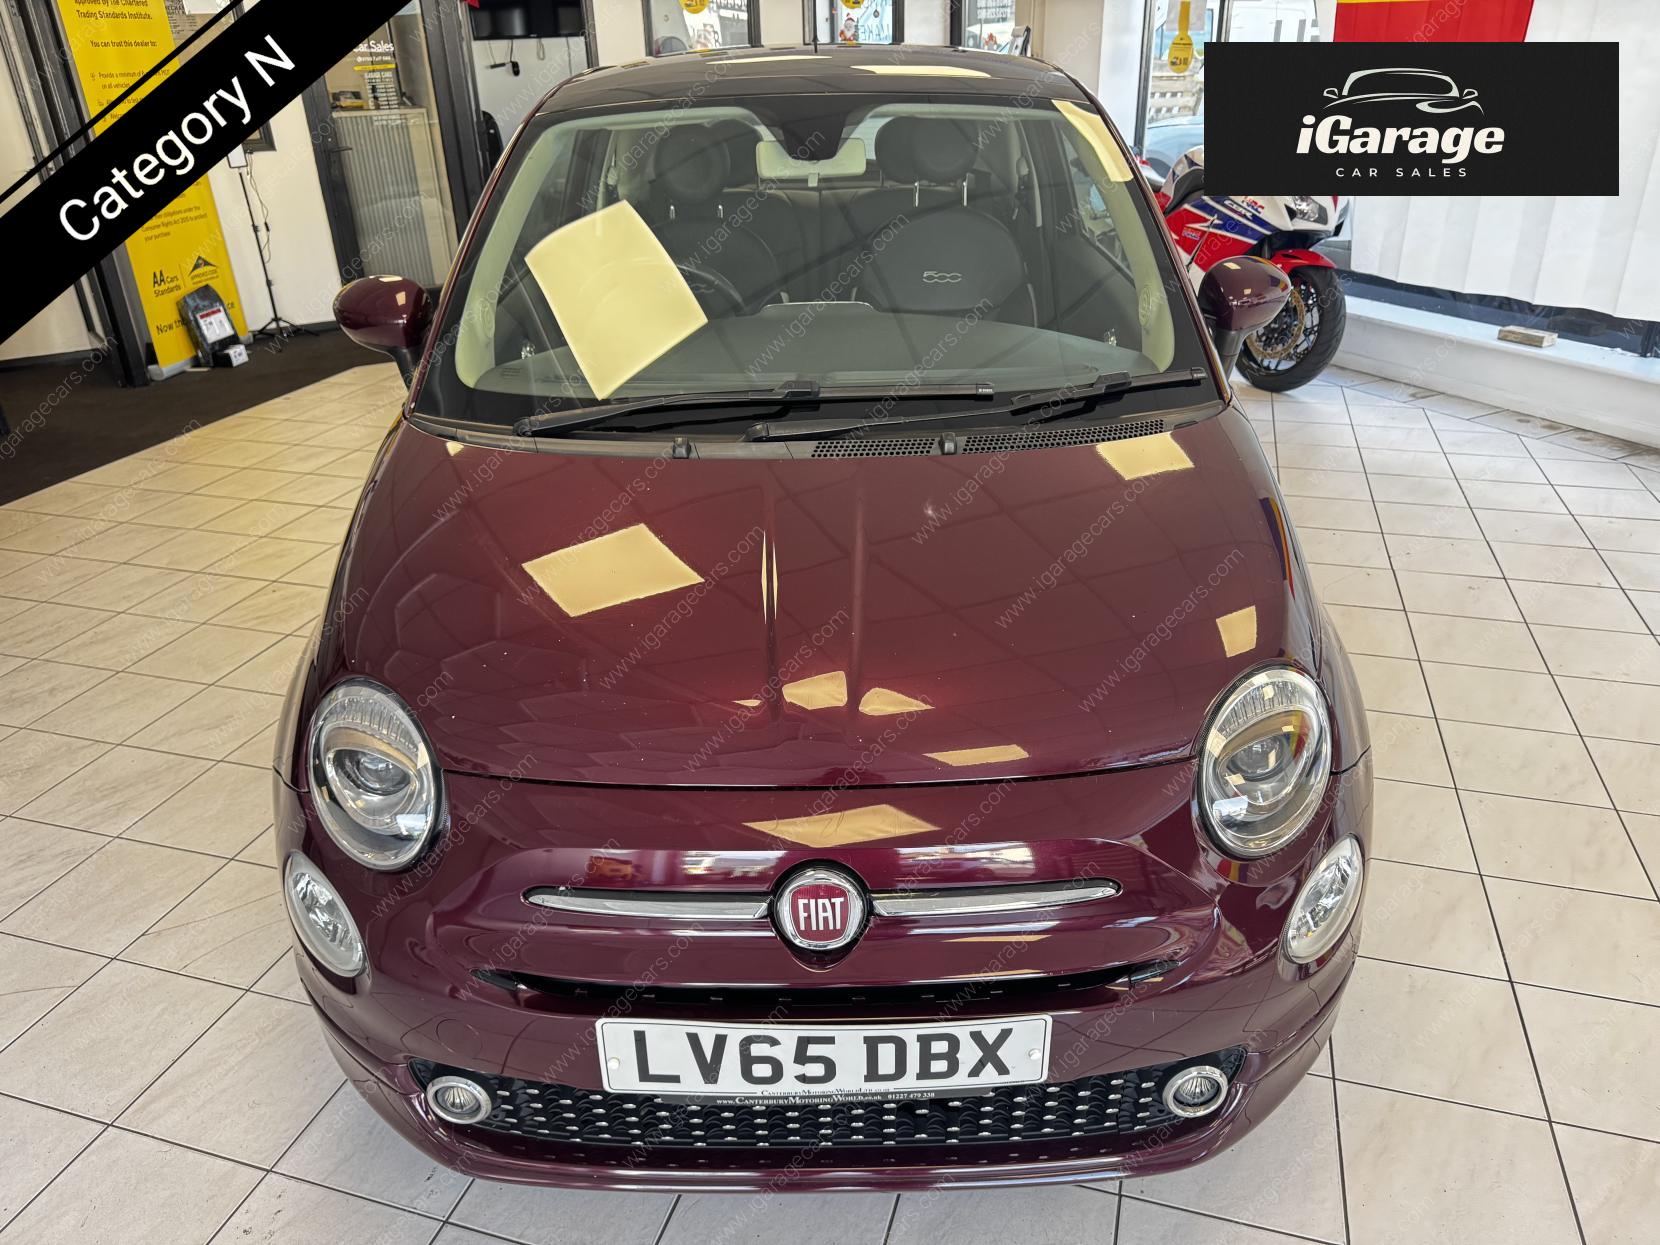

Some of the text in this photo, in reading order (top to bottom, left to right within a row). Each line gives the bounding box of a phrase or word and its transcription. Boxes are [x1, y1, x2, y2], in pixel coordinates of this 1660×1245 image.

[76, 9, 98, 20] Trading
[98, 10, 128, 20] Standards
[128, 12, 153, 20] Institute.
[369, 40, 394, 52] Sales
[153, 268, 166, 288] AA
[166, 274, 179, 283] Cars
[922, 270, 962, 282] 500
[153, 284, 182, 298] Standards
[156, 322, 173, 336] Now
[797, 897, 844, 931] FIAT
[633, 1028, 1013, 1085] LV65 DBX
